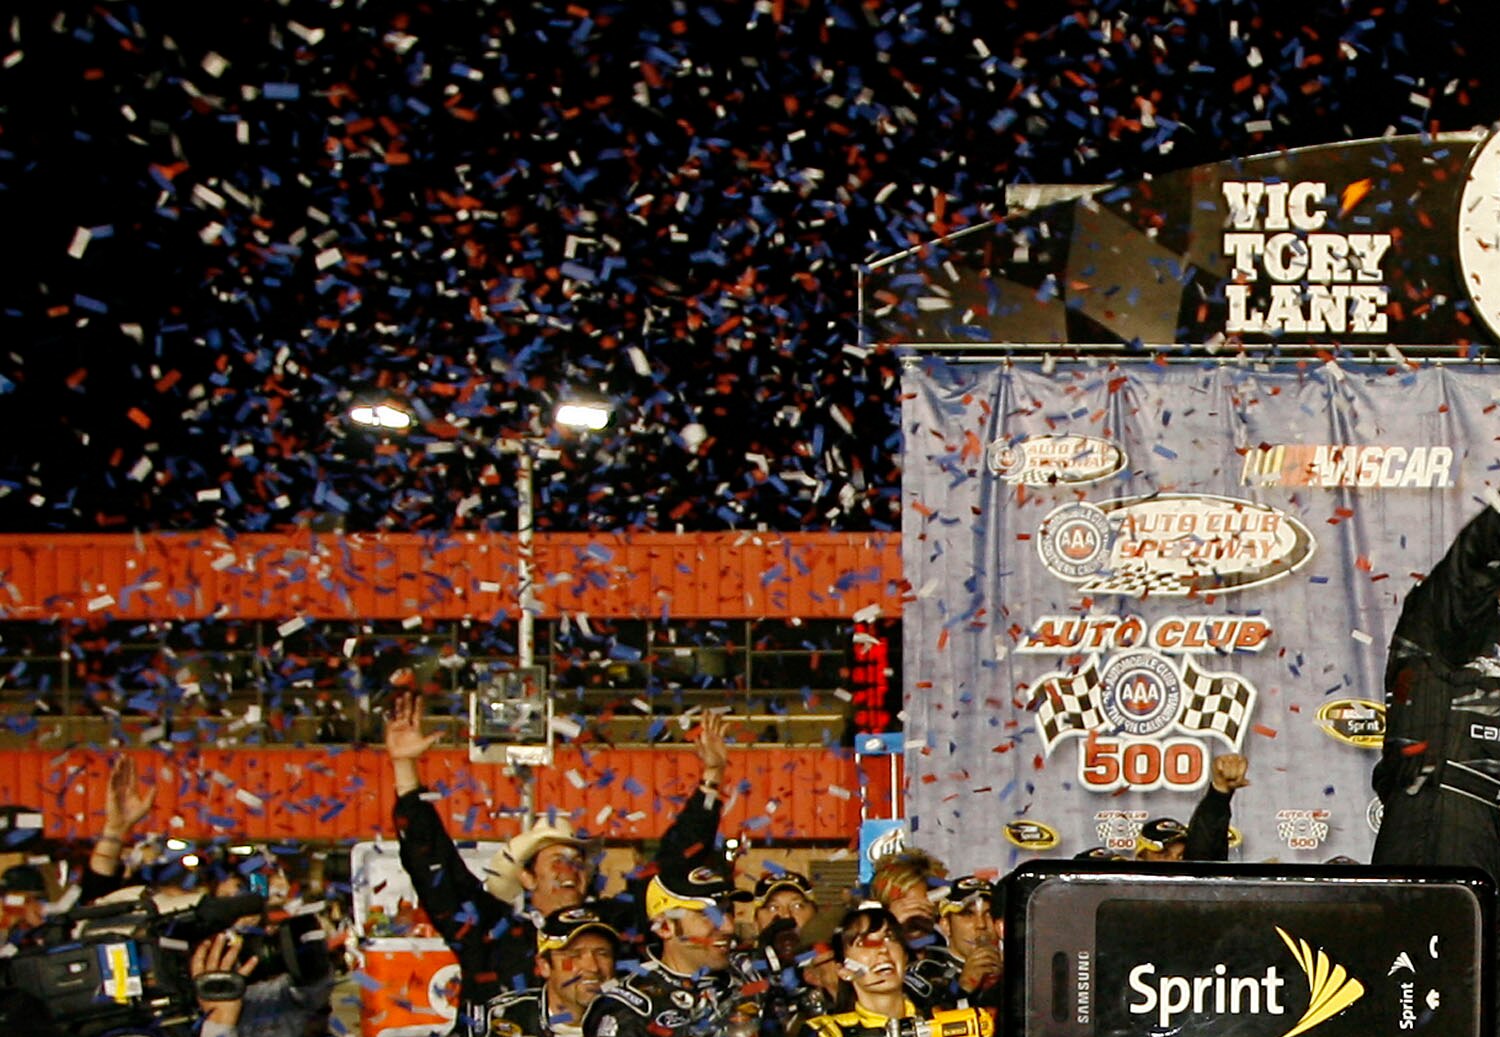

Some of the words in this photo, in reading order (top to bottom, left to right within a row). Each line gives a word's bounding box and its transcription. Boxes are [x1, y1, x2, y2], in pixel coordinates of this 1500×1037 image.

[1222, 182, 1326, 229] VIC
[1223, 234, 1390, 281] TORY
[1224, 285, 1388, 333] LANE
[1310, 446, 1453, 487] NASCAR
[1119, 514, 1197, 532] AUTO
[1207, 514, 1280, 532] CLUB
[1026, 618, 1142, 647] AUTO
[1155, 620, 1268, 647] CLUB
[1121, 682, 1159, 703] AAA
[1084, 742, 1203, 785] 500
[1109, 838, 1135, 848] 500
[1289, 838, 1317, 848] 500
[1077, 951, 1090, 1024] SAMSUNG
[1129, 962, 1285, 1028] Sprint
[1399, 981, 1415, 1029] Sprint
